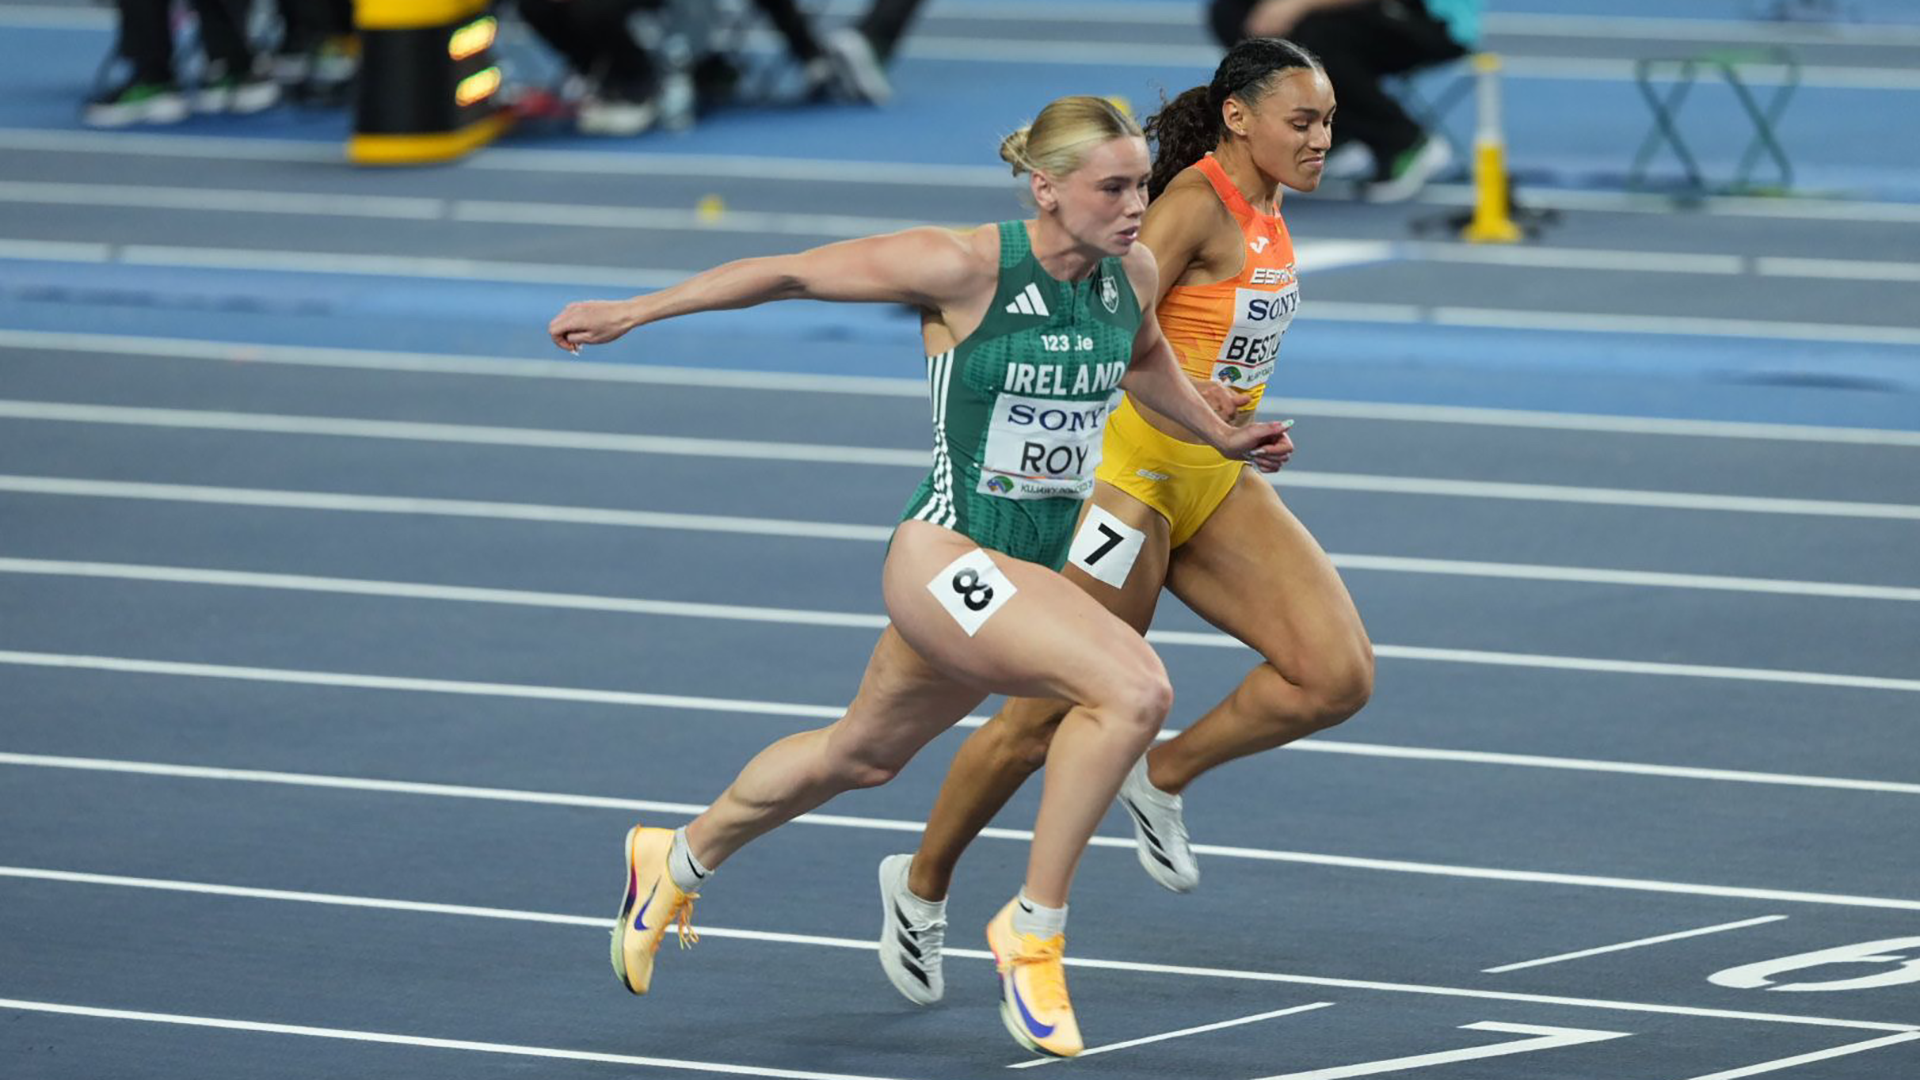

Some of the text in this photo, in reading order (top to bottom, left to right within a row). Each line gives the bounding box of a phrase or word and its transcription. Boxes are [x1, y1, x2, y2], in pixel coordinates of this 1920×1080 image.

[1247, 290, 1298, 321] SONY
[1041, 335, 1070, 351] 123
[1003, 361, 1126, 395] IRELAND
[1008, 404, 1106, 432] SONY
[1020, 441, 1089, 475] ROY
[1084, 522, 1124, 566] 7
[952, 567, 994, 611] 8
[1250, 1020, 1636, 1080] 7
